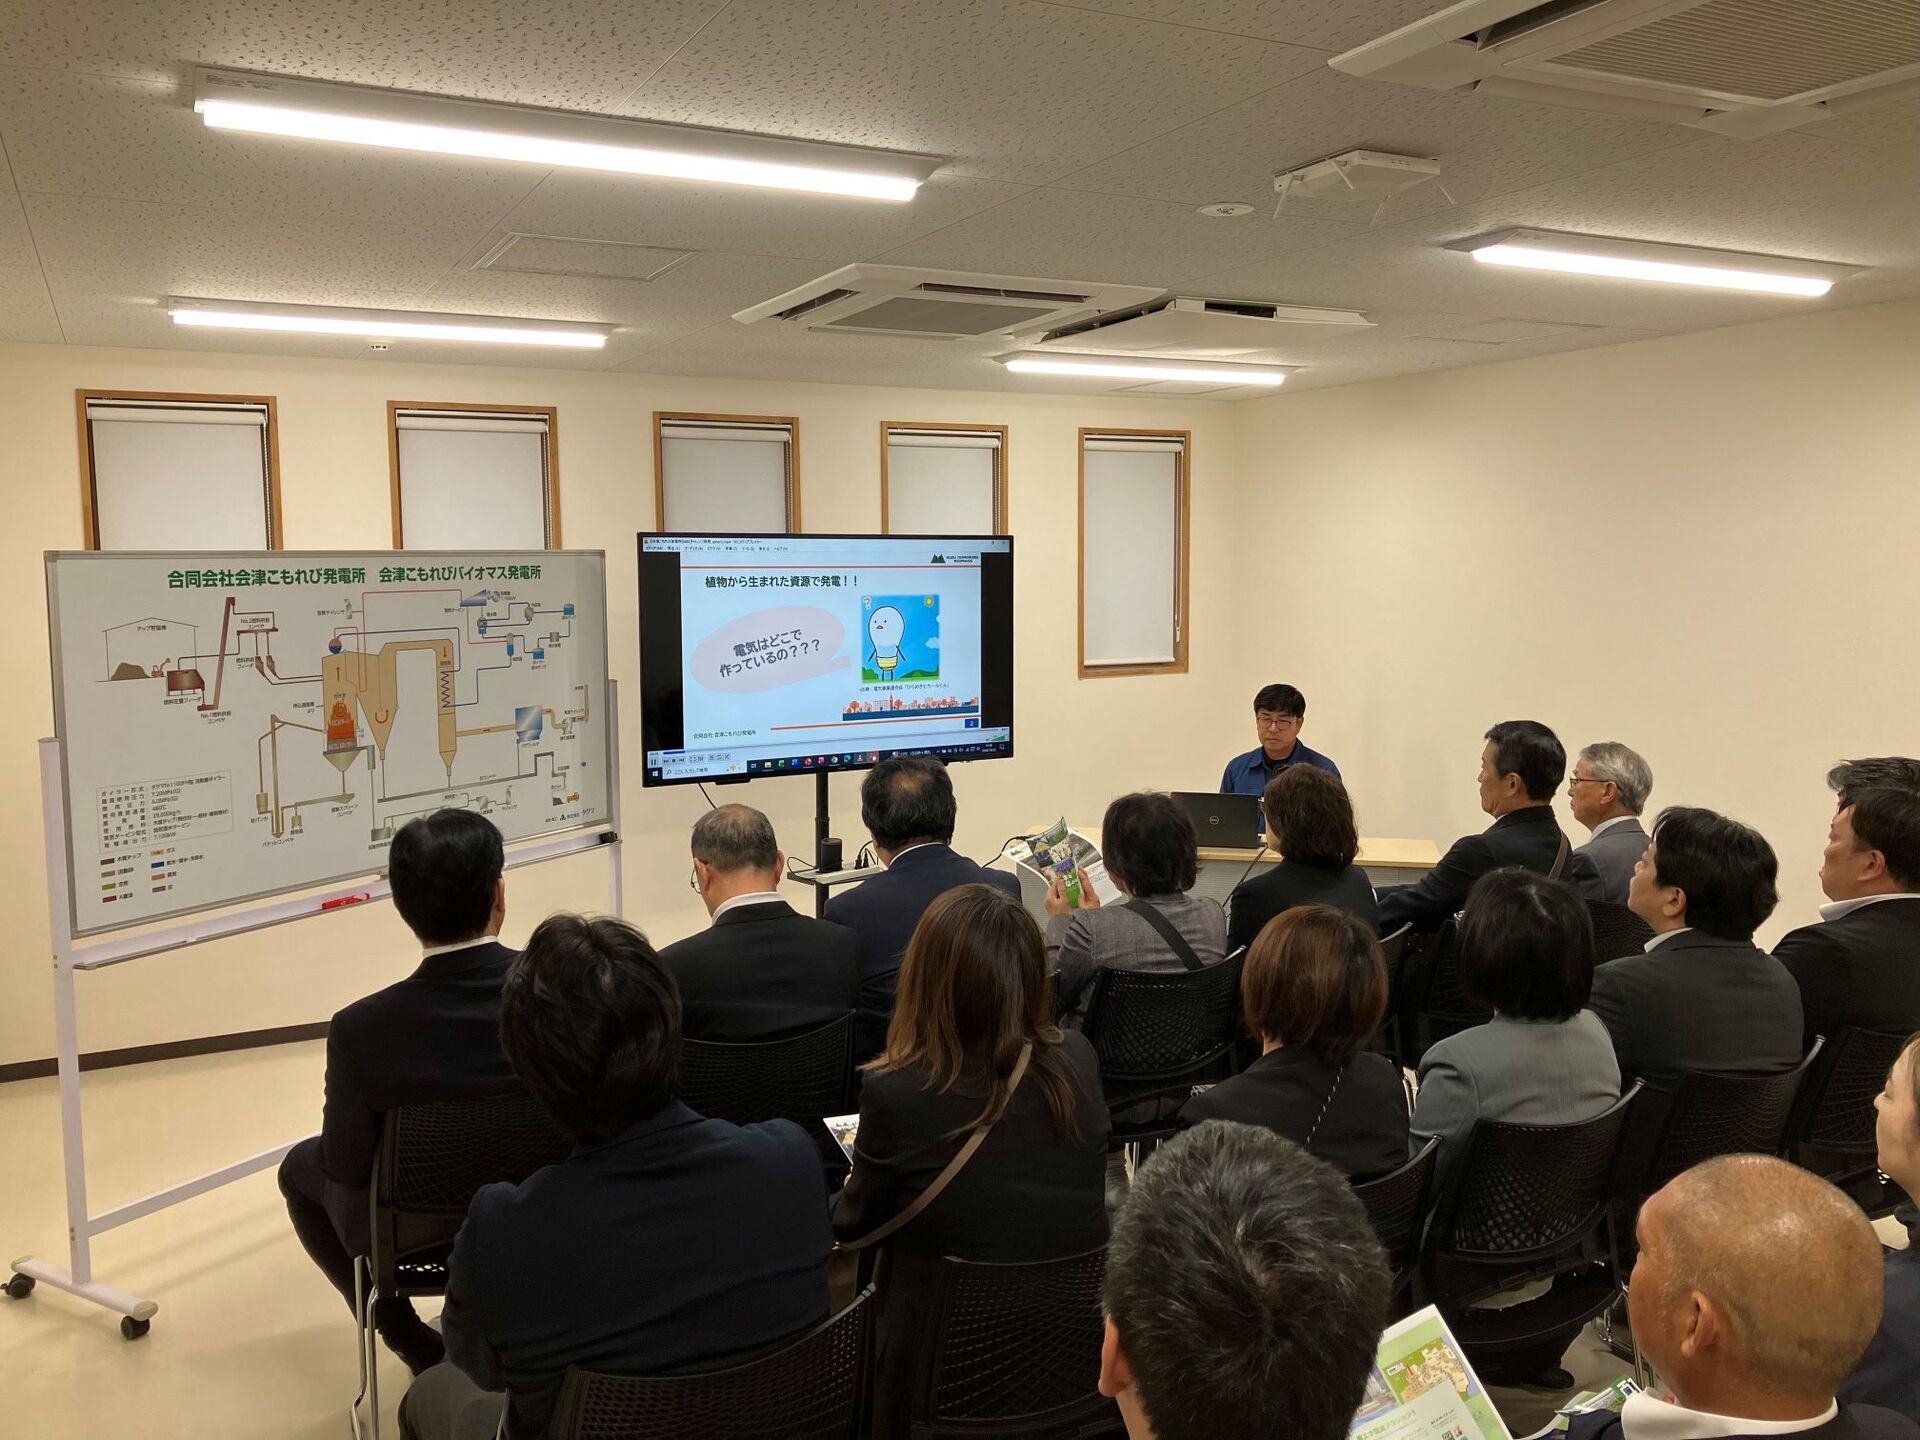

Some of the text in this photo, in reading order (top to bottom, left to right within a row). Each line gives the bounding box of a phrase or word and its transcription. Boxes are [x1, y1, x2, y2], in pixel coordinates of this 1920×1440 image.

[167, 564, 542, 589] 合同会社会津こもれび発電所 会津こもれびバイオマス発電所
[705, 575, 858, 588] 植物から生まれた資源で発電！！
[732, 629, 802, 658] 電気はどこで
[719, 639, 820, 678] 作っているの？？？
